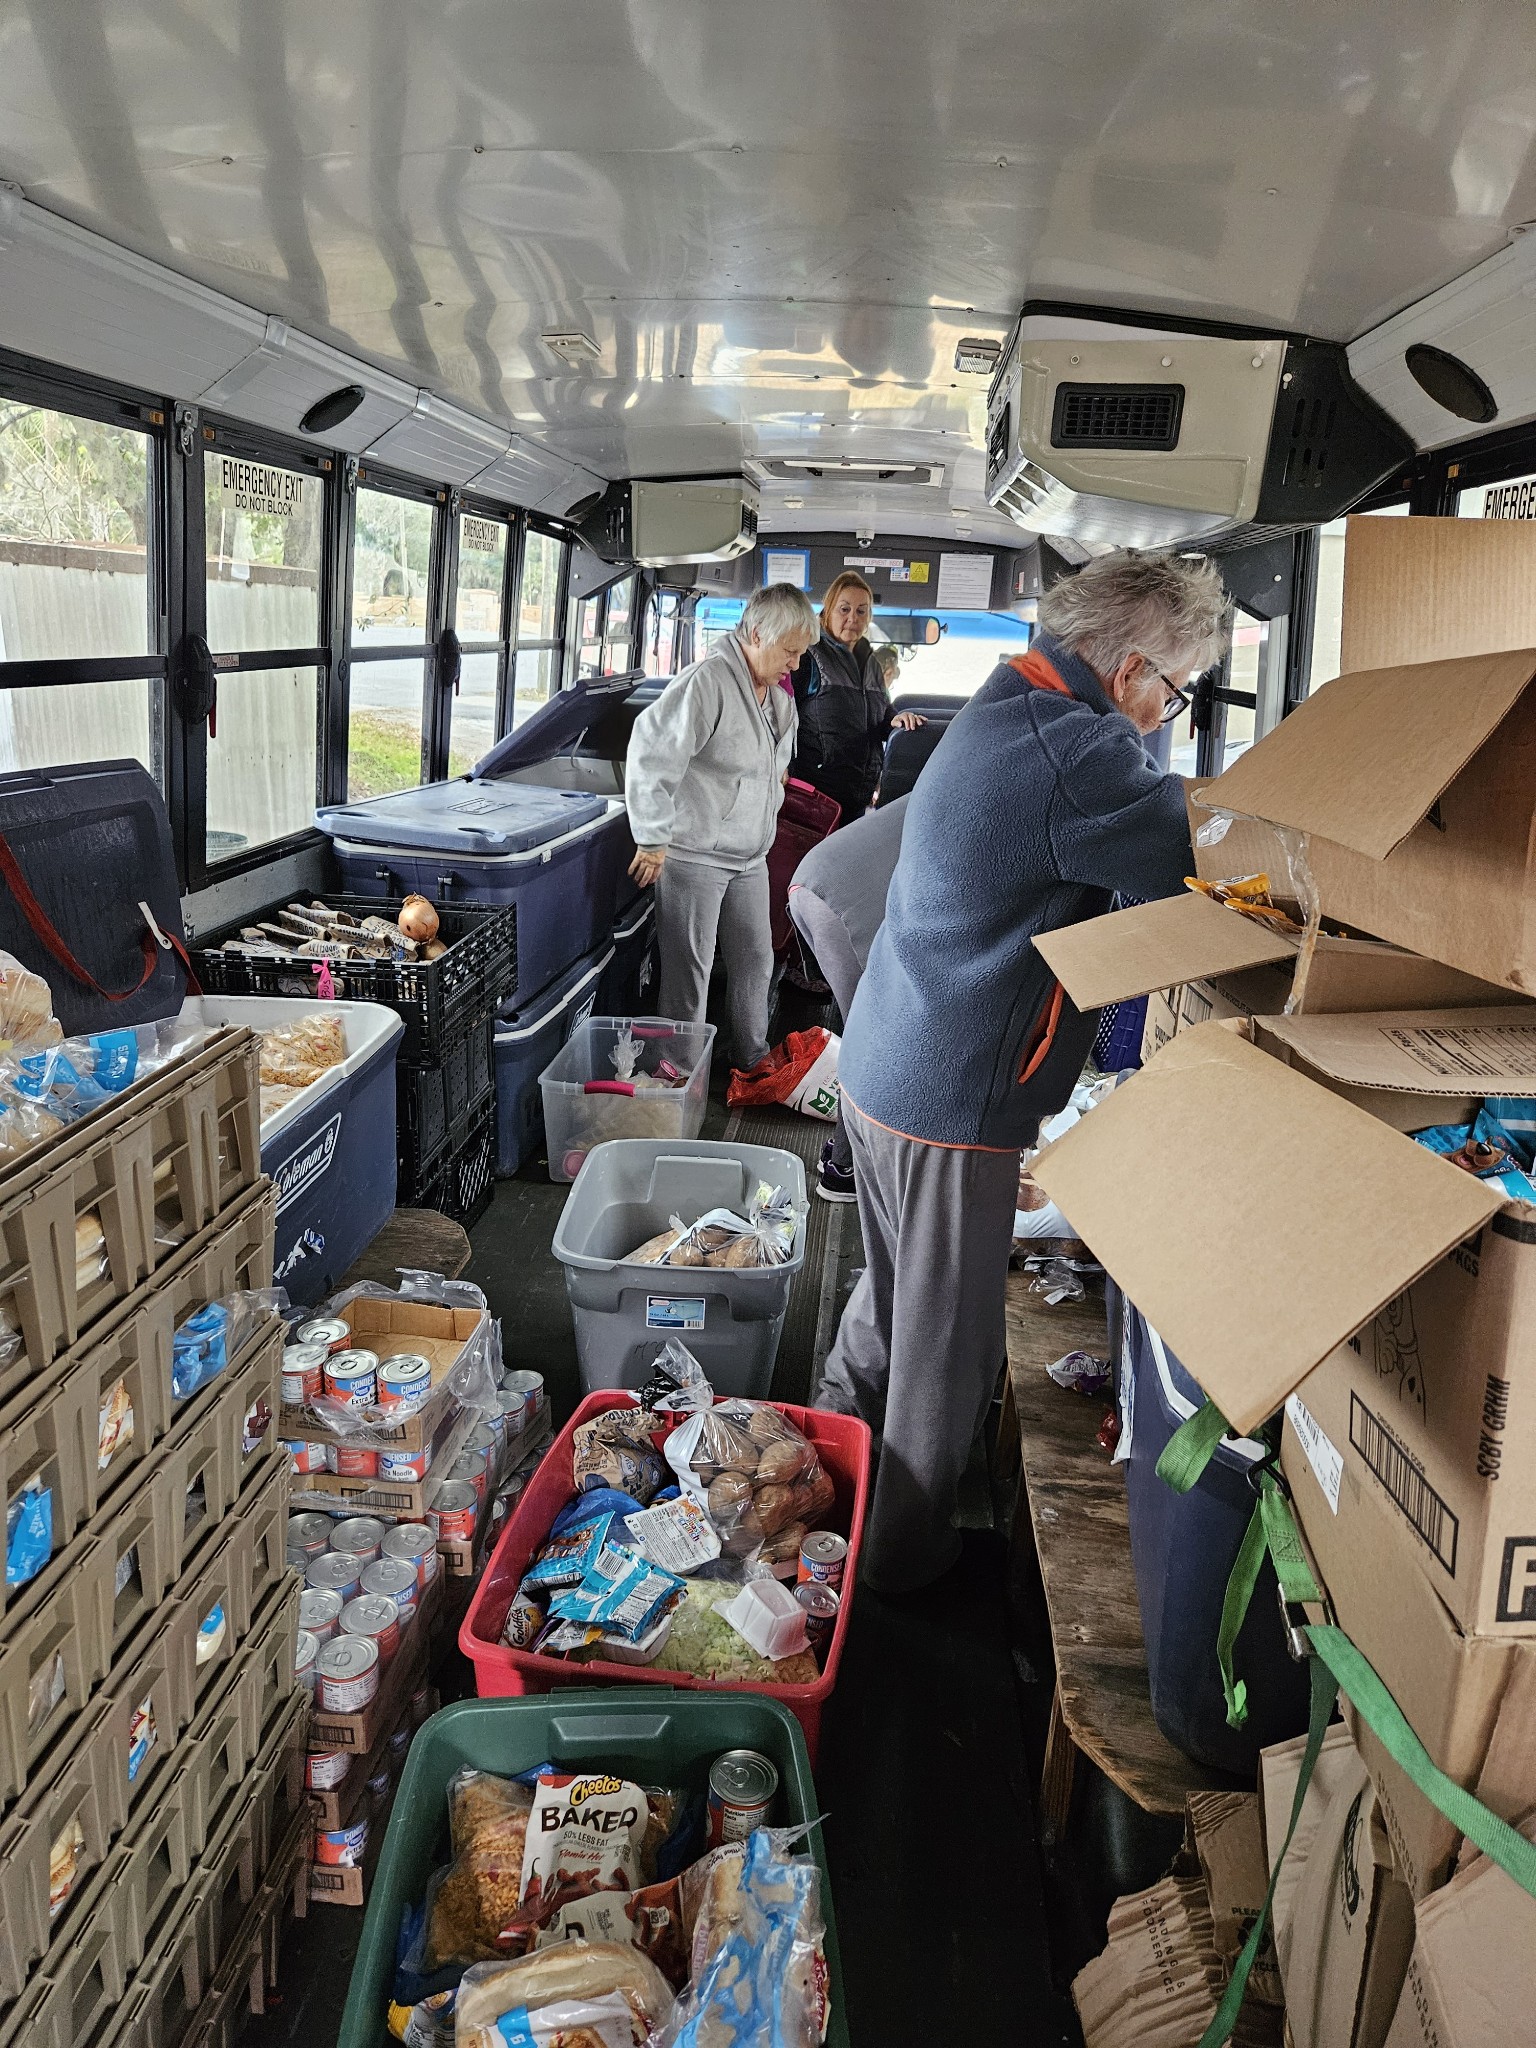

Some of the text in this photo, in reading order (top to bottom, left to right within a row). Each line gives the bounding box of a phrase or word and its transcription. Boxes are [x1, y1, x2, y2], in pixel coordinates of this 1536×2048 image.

[222, 459, 304, 503] EMERGENCY EXIT
[1484, 481, 1536, 519] EMERGE
[235, 493, 293, 516] DO NOT BLOCK
[278, 1143, 324, 1194] Coleman
[1476, 1372, 1511, 1481] SCBY GRHM
[392, 1469, 413, 1477] Noodle
[569, 1775, 623, 1807] Cheetos
[541, 1806, 638, 1833] BAKED
[563, 1830, 609, 1847] 50% LESS FAT
[1142, 1899, 1175, 1995] FOODSERVICE
[1149, 1897, 1179, 1968] VENDING
